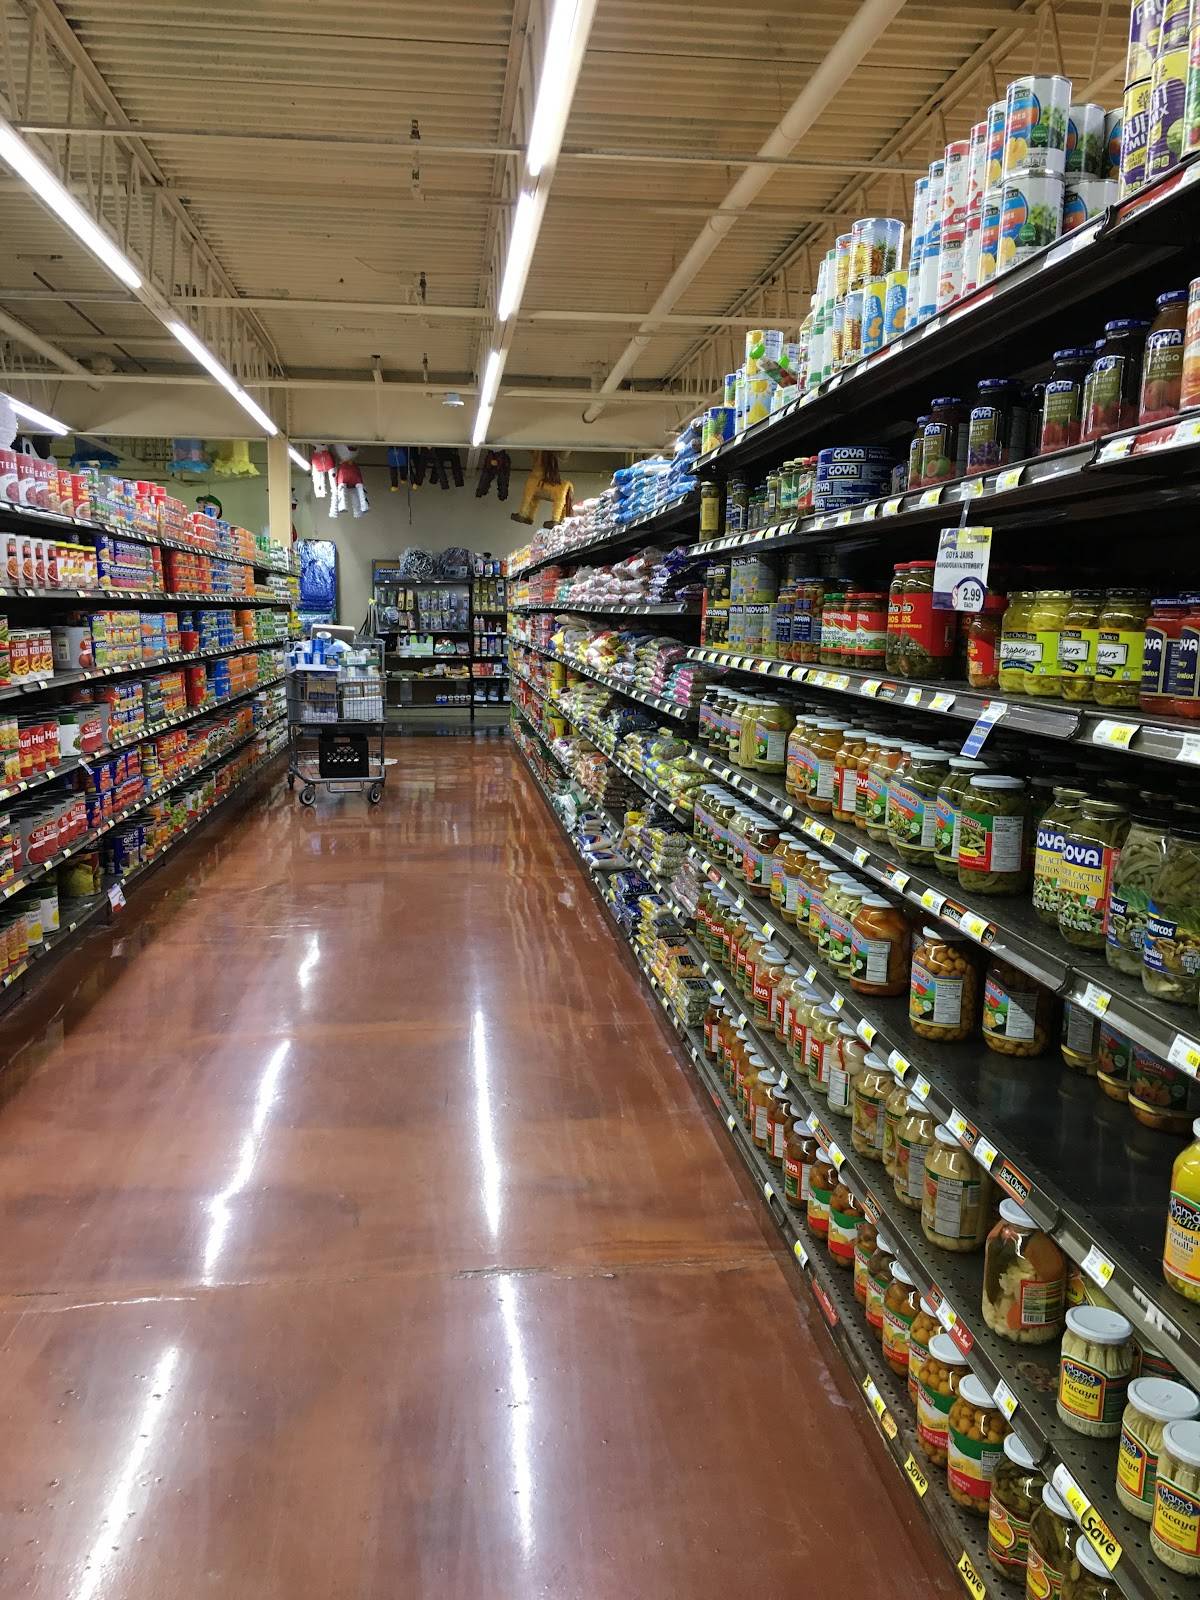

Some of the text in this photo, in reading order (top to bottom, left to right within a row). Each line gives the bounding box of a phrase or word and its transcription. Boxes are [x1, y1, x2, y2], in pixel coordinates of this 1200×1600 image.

[972, 409, 992, 419] OYA
[833, 448, 865, 460] GOYA
[828, 465, 858, 477] GOYA
[816, 482, 830, 493] OYA
[963, 587, 981, 602] 2.99
[1039, 832, 1066, 851] OYA
[1066, 845, 1099, 867] OYA
[1073, 871, 1102, 883] CACTUS
[1001, 1168, 1027, 1199] Best Choice
[1064, 1378, 1098, 1400] Pacaya
[906, 1461, 926, 1488] Save
[1158, 1503, 1197, 1533] Pacaya
[1082, 1516, 1116, 1556] Save
[960, 1560, 983, 1593] Save
